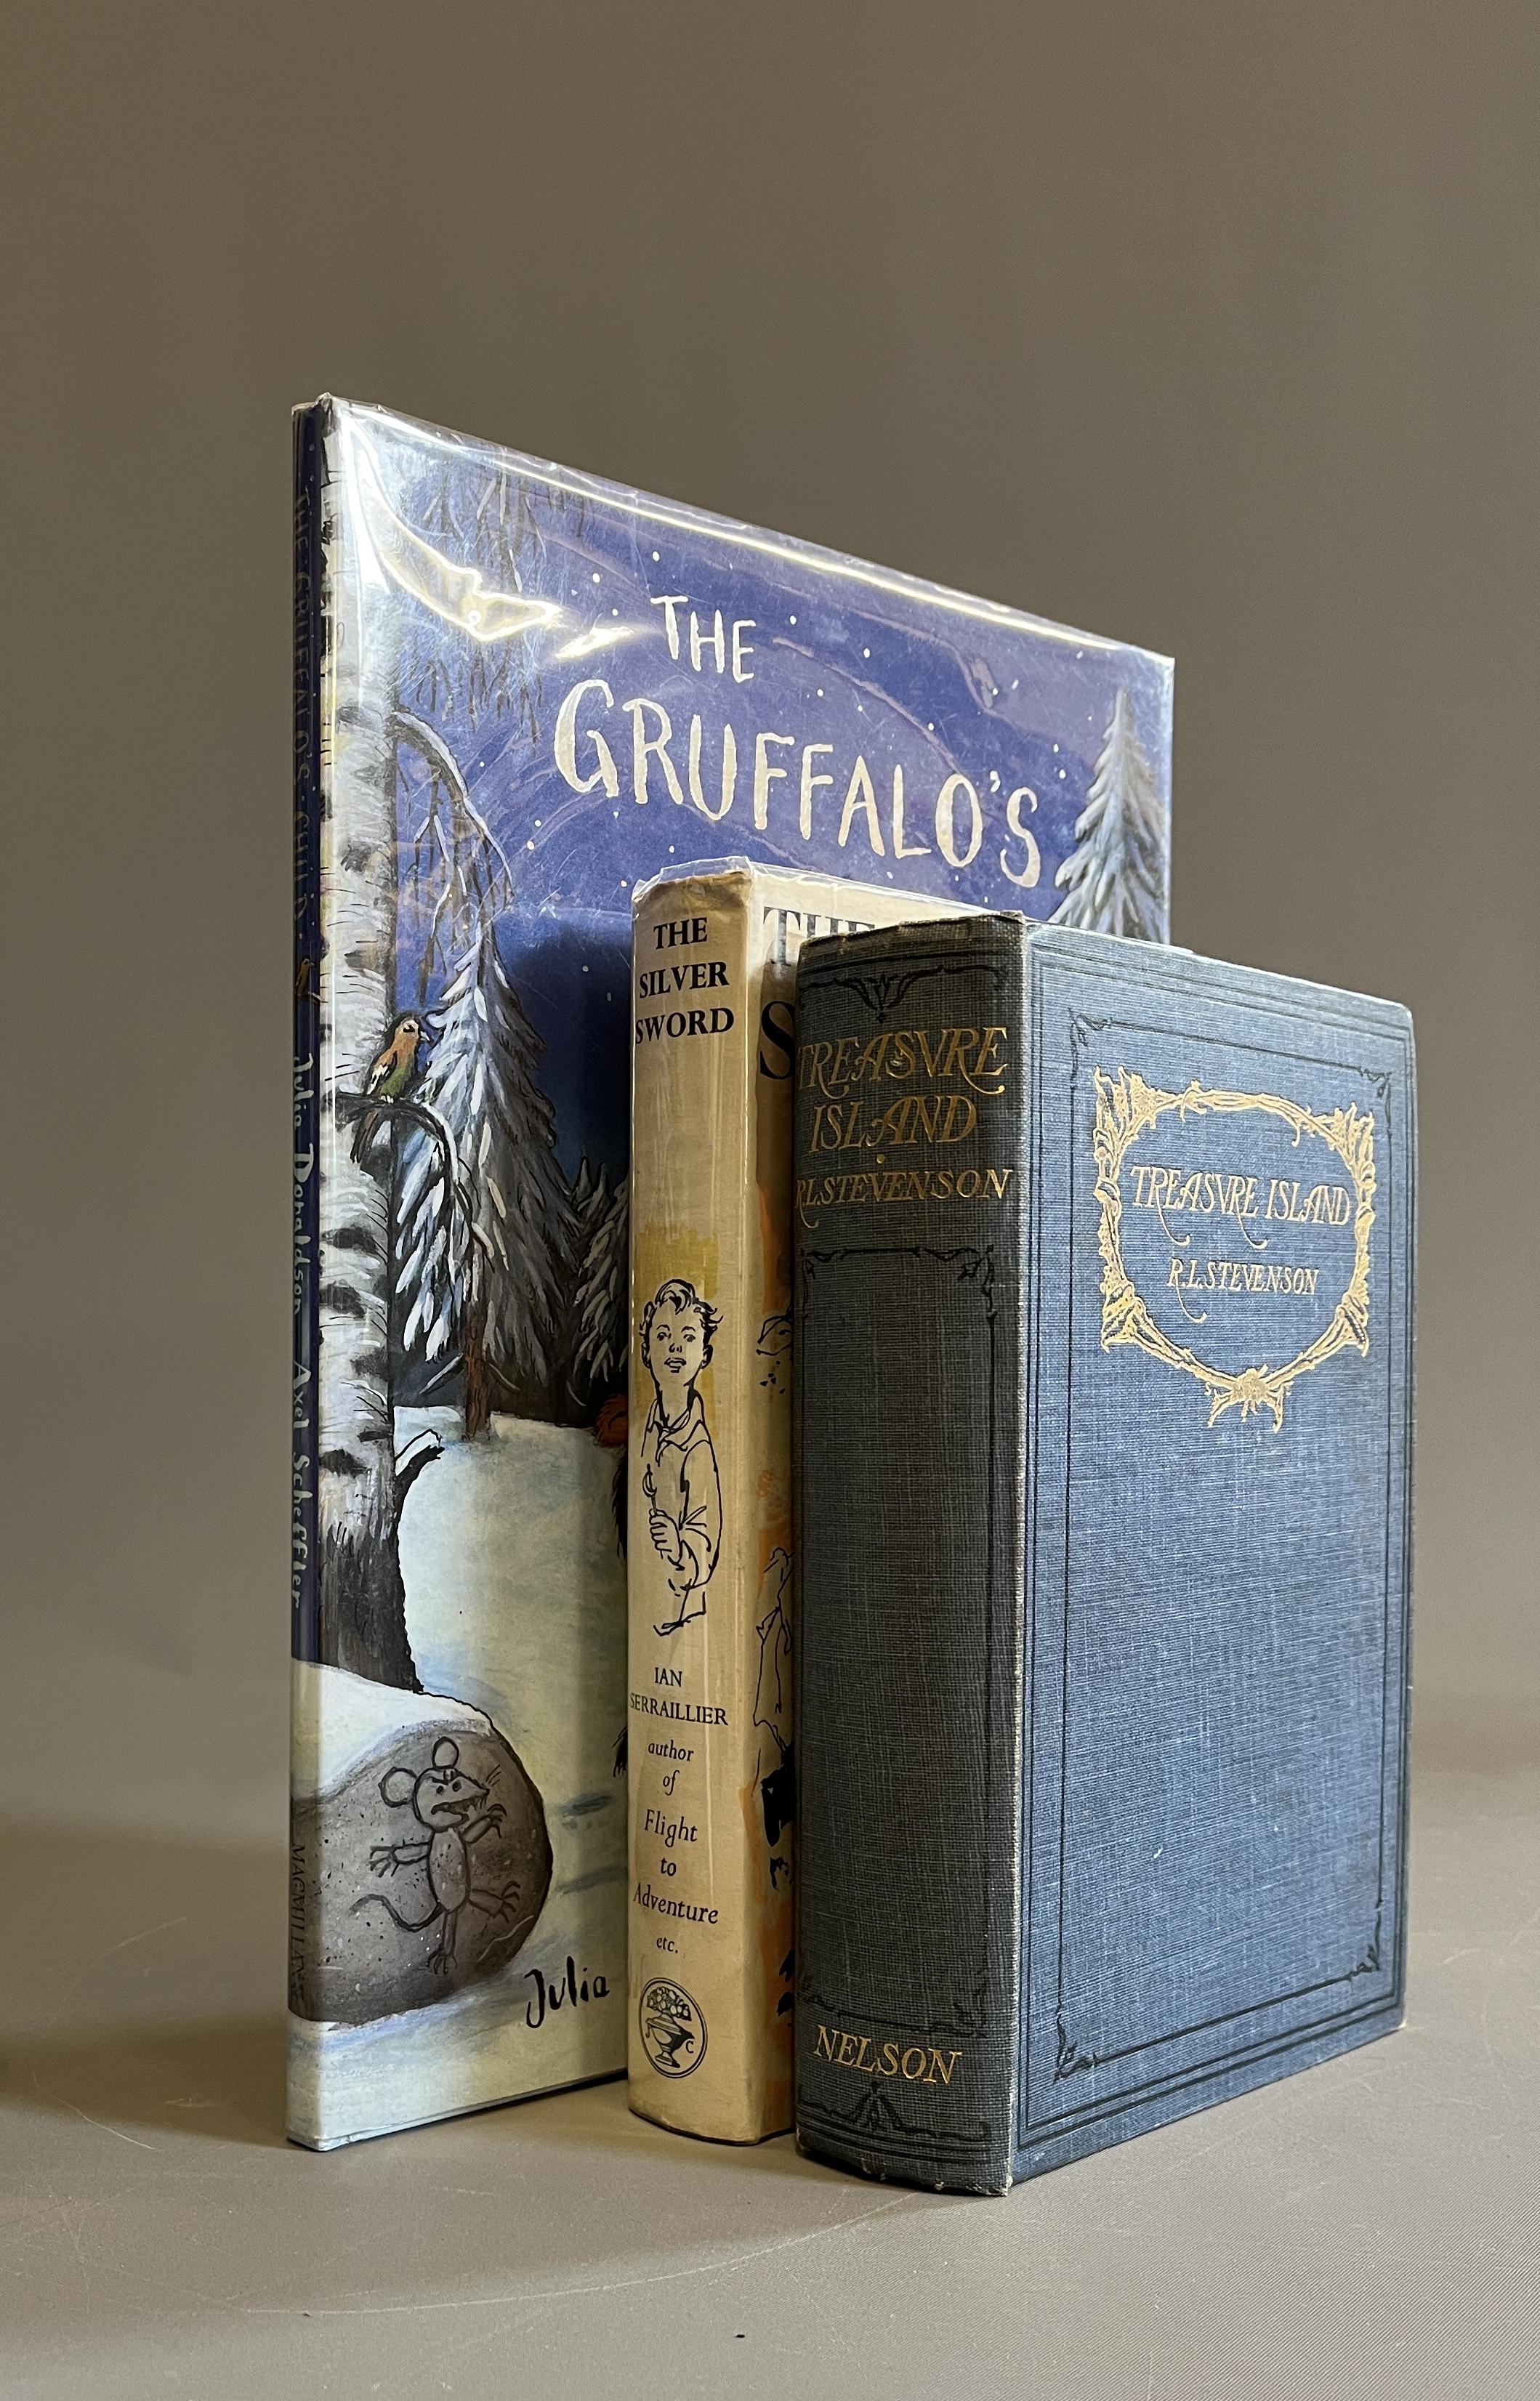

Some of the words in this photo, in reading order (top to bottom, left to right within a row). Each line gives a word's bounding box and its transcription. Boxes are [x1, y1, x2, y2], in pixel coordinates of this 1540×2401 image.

[650, 594, 757, 683] THE
[553, 679, 1041, 888] GRUFFALO'S
[653, 916, 708, 950] THE
[639, 961, 730, 998] SILVER
[635, 1007, 735, 1044] SWORD
[807, 1094, 977, 1154] ISLAND
[1266, 1178, 1350, 1227] ISLAND
[293, 1142, 315, 1316] Donaldson
[292, 1360, 312, 1430] Axel
[654, 1666, 682, 1688] IAN
[629, 1692, 729, 1727] SERRAILLIER
[648, 1739, 694, 1762] author
[662, 1769, 680, 1796] of
[644, 1808, 698, 1848] Flight
[660, 1856, 677, 1877] to
[633, 1881, 719, 1925] Adventure
[656, 1936, 679, 1954] etc.
[524, 1955, 610, 2029] Julia
[813, 2024, 963, 2084] NELSON
